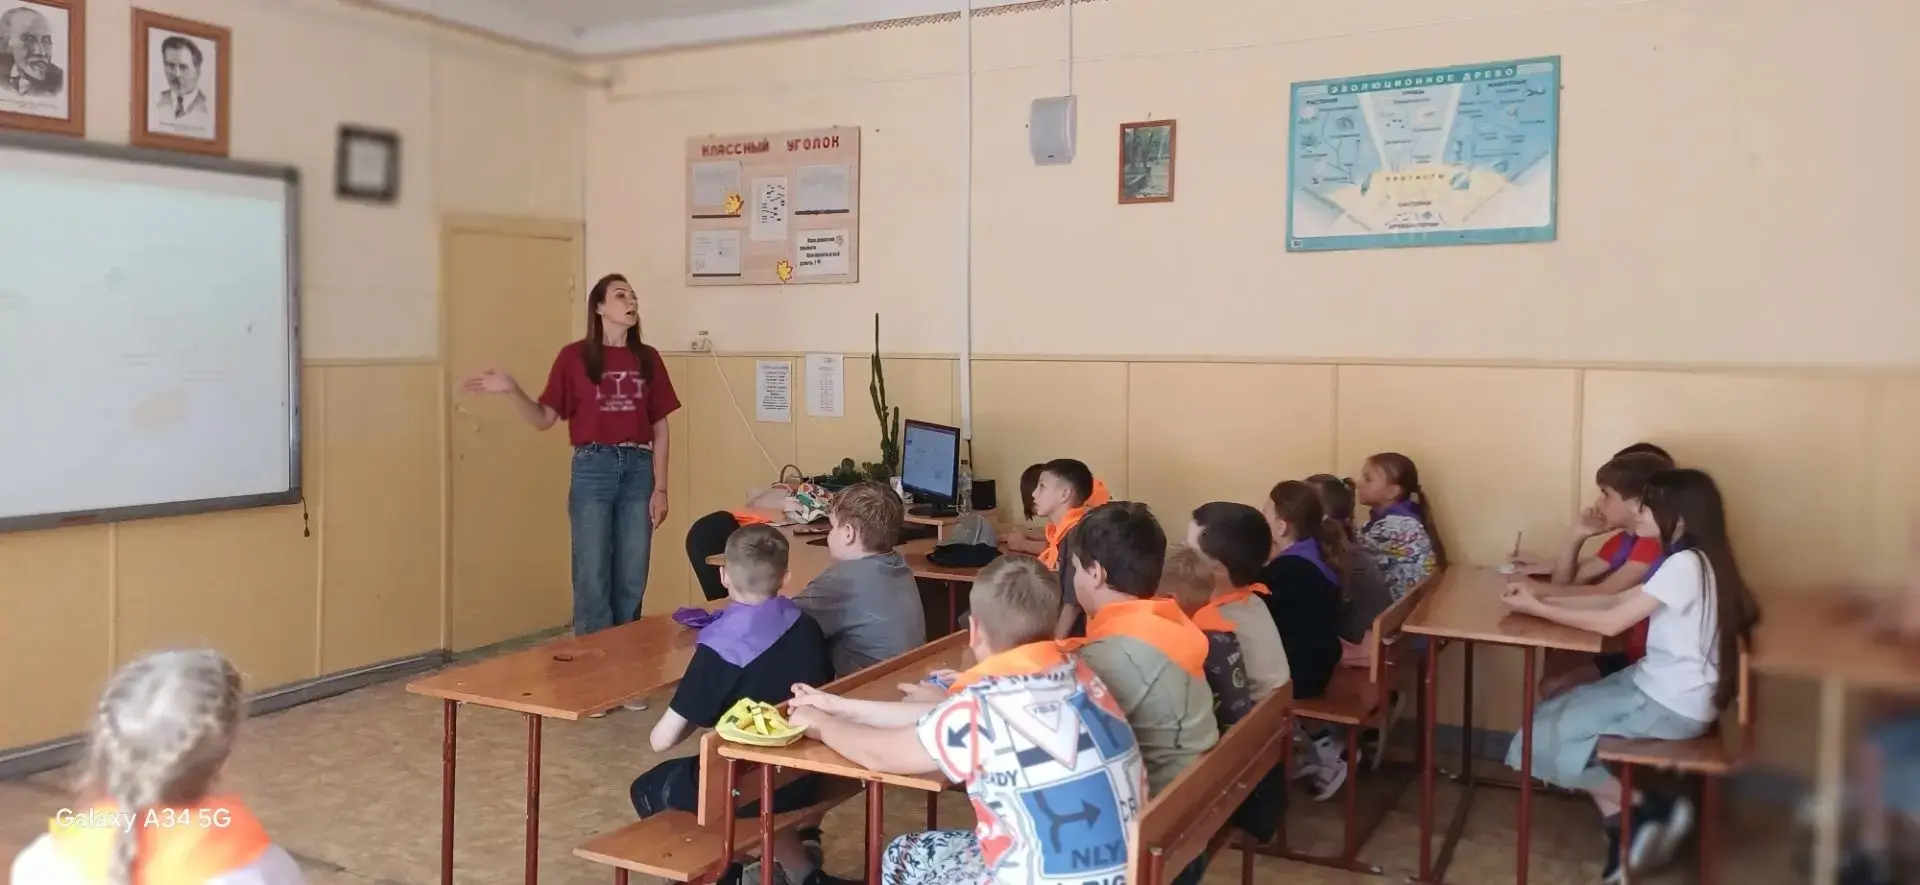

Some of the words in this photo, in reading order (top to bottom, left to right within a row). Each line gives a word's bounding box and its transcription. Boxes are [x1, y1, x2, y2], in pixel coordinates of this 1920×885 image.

[1331, 73, 1455, 94] ЭВОЛЮЦИОННОЕ
[1463, 67, 1514, 82] ДРЕВО
[702, 138, 770, 157] КЛАССНЫЙ
[786, 135, 840, 152] УГОЛОК
